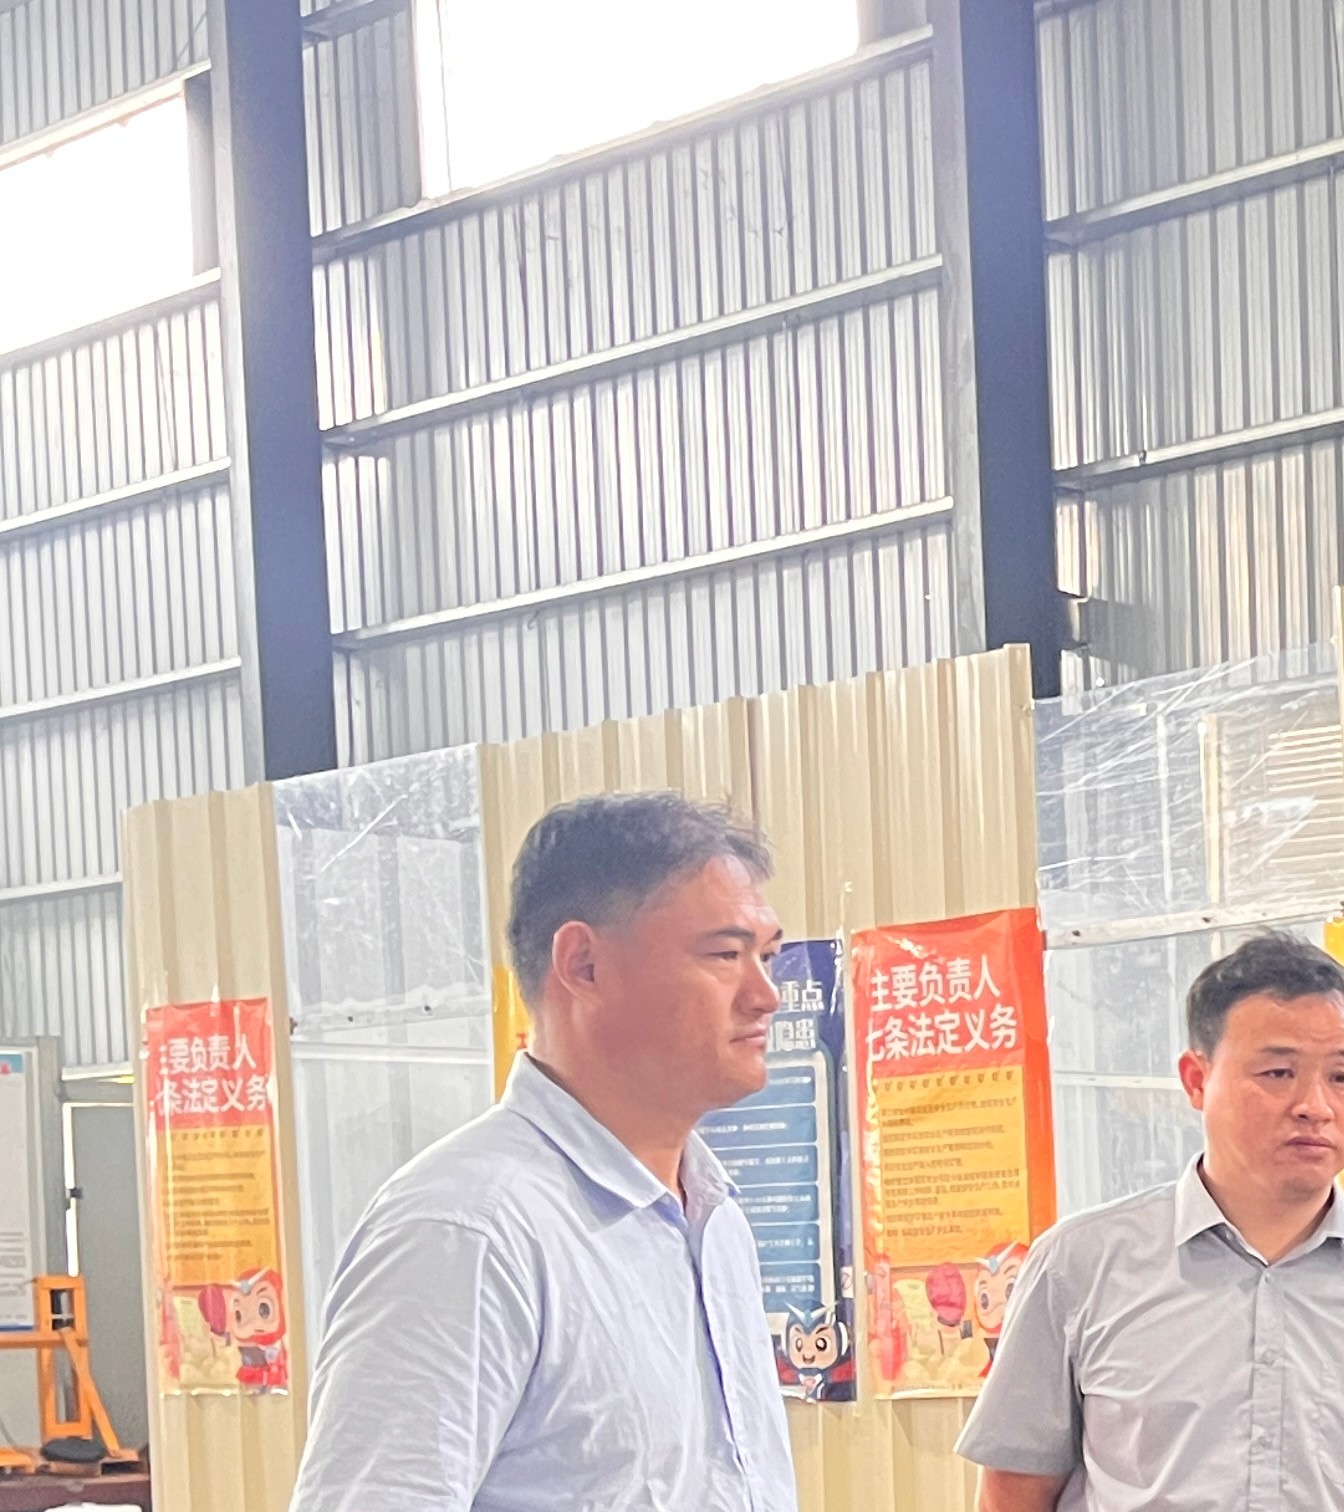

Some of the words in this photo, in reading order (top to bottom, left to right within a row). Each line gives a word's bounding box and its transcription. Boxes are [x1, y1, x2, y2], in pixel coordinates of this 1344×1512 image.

[870, 953, 1001, 1012] 主要负责人
[768, 1018, 817, 1052] 隐患
[865, 1003, 1017, 1063] 七条法定义务
